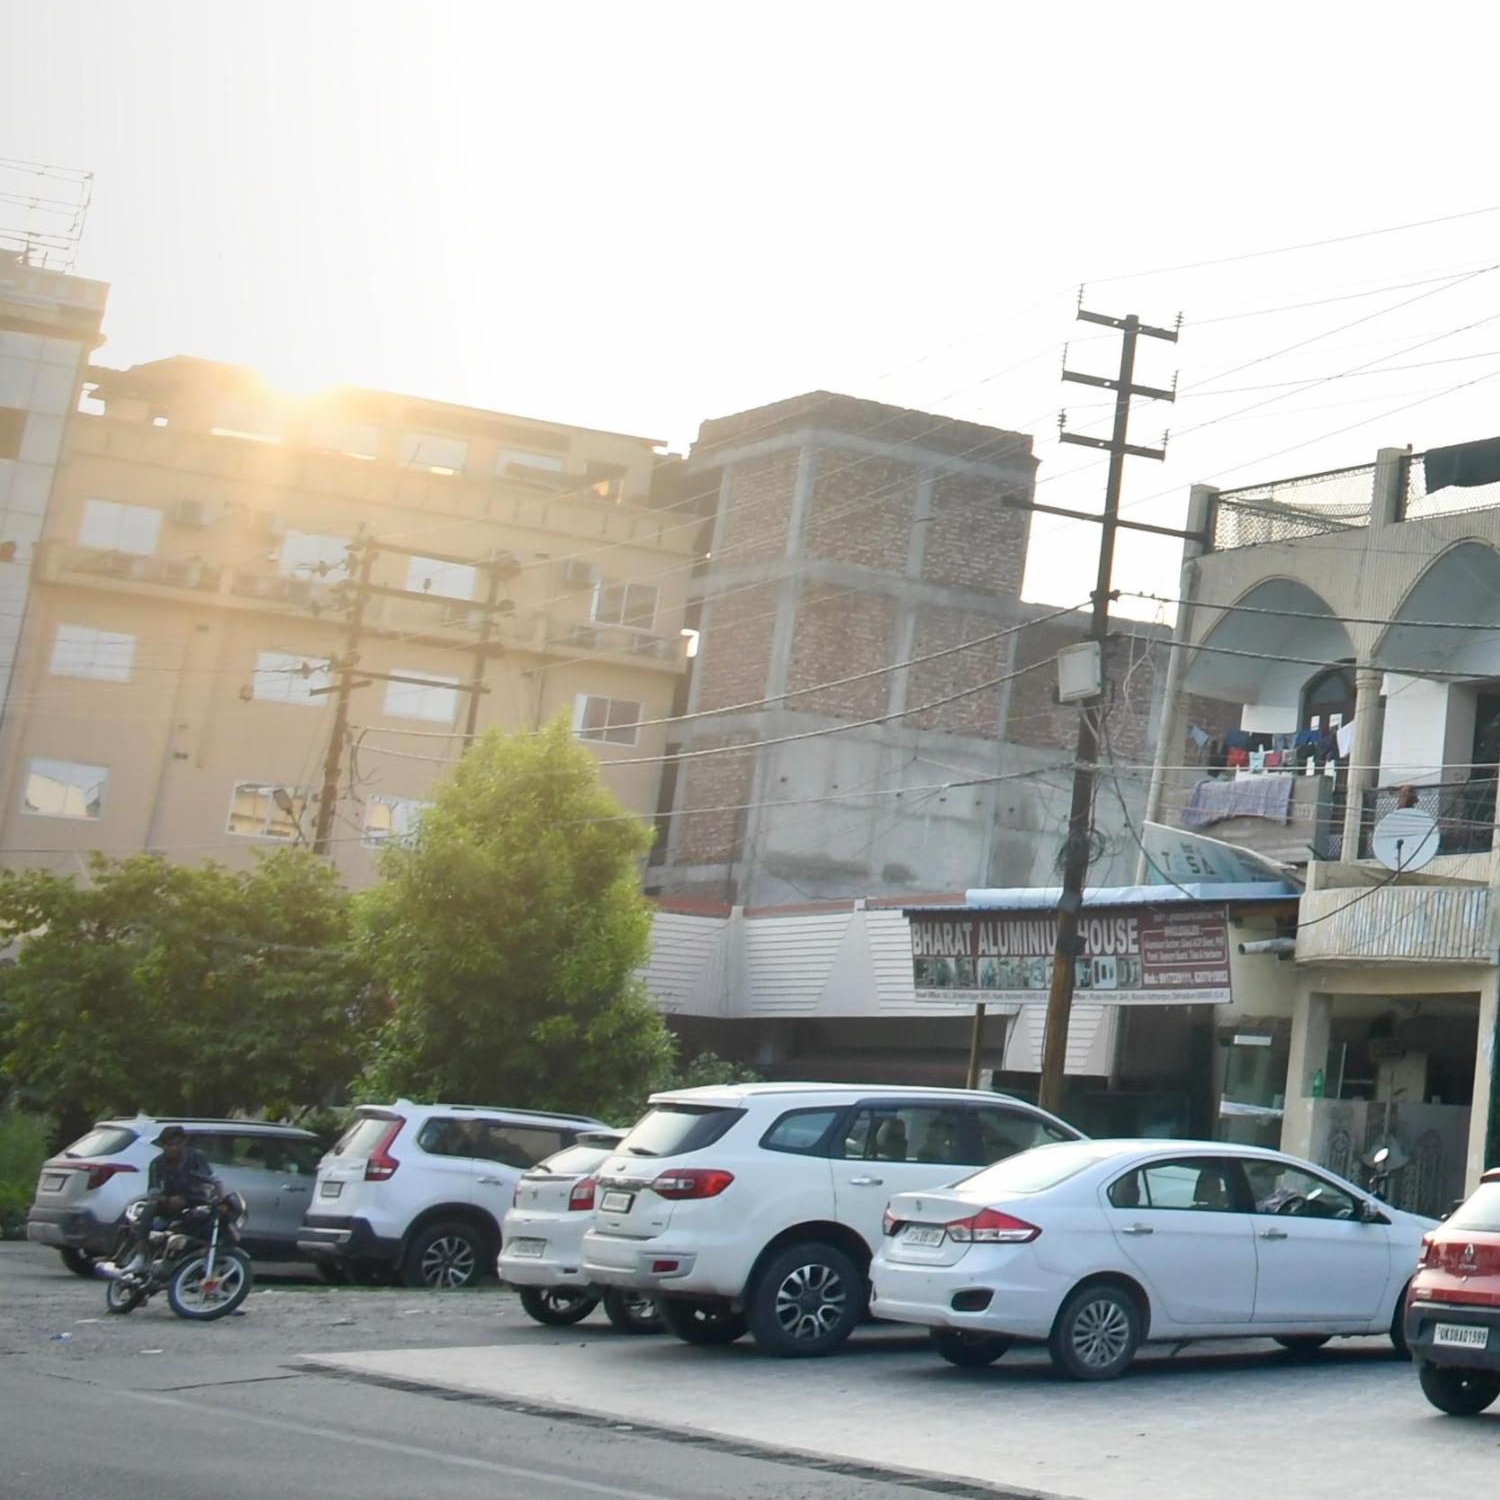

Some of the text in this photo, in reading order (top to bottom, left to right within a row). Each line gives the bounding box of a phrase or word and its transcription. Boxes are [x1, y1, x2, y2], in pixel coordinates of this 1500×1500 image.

[912, 917, 1139, 955] BHARAT ALUMINIU HOUSE
